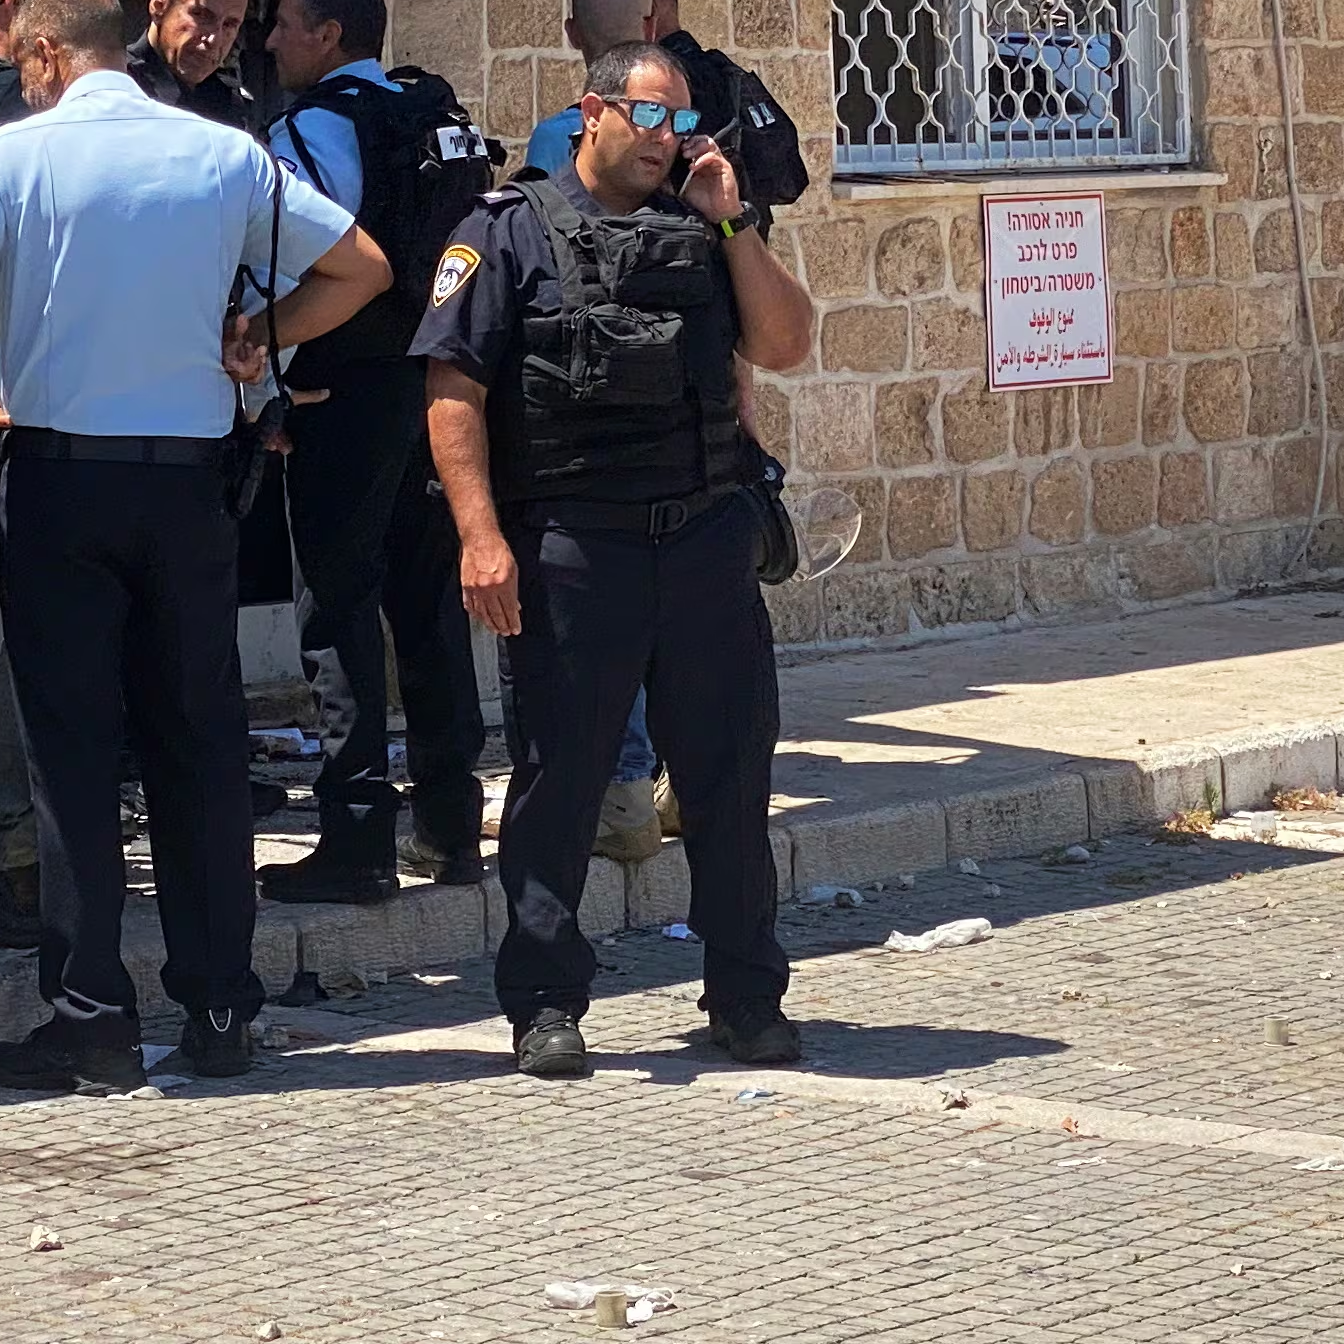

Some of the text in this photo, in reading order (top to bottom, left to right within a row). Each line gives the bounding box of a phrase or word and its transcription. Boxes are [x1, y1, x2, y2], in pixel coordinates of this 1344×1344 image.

[1006, 210, 1084, 232] חניה אסורה!
[1017, 238, 1078, 263] פרט לרכב
